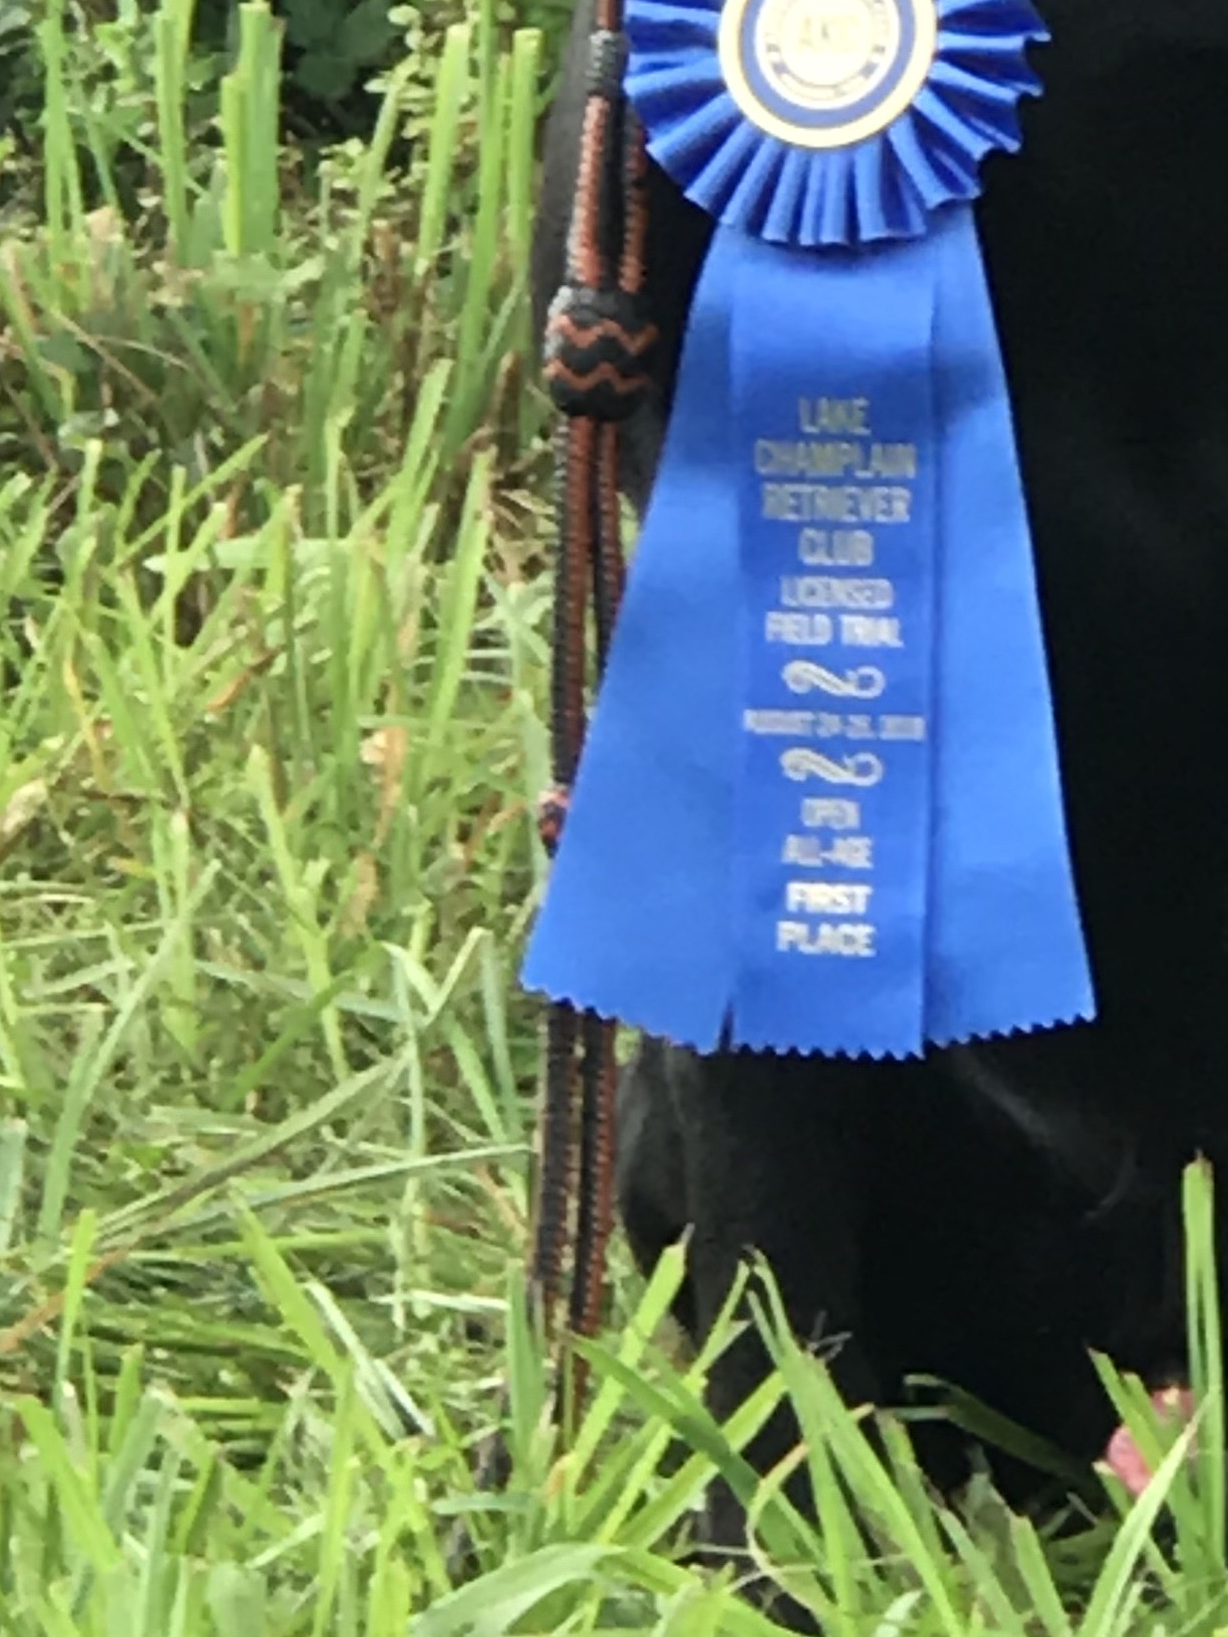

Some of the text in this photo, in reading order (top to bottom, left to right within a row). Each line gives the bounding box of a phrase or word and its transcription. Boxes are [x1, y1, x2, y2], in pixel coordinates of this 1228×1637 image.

[799, 397, 871, 435] LAKE
[754, 438, 917, 479] CHAMPLAIN
[762, 482, 912, 523] RETRIEVER
[798, 526, 874, 566] CLUB
[780, 575, 894, 610] LICENSED
[786, 881, 873, 914] FIRST
[776, 920, 876, 957] PLACE
